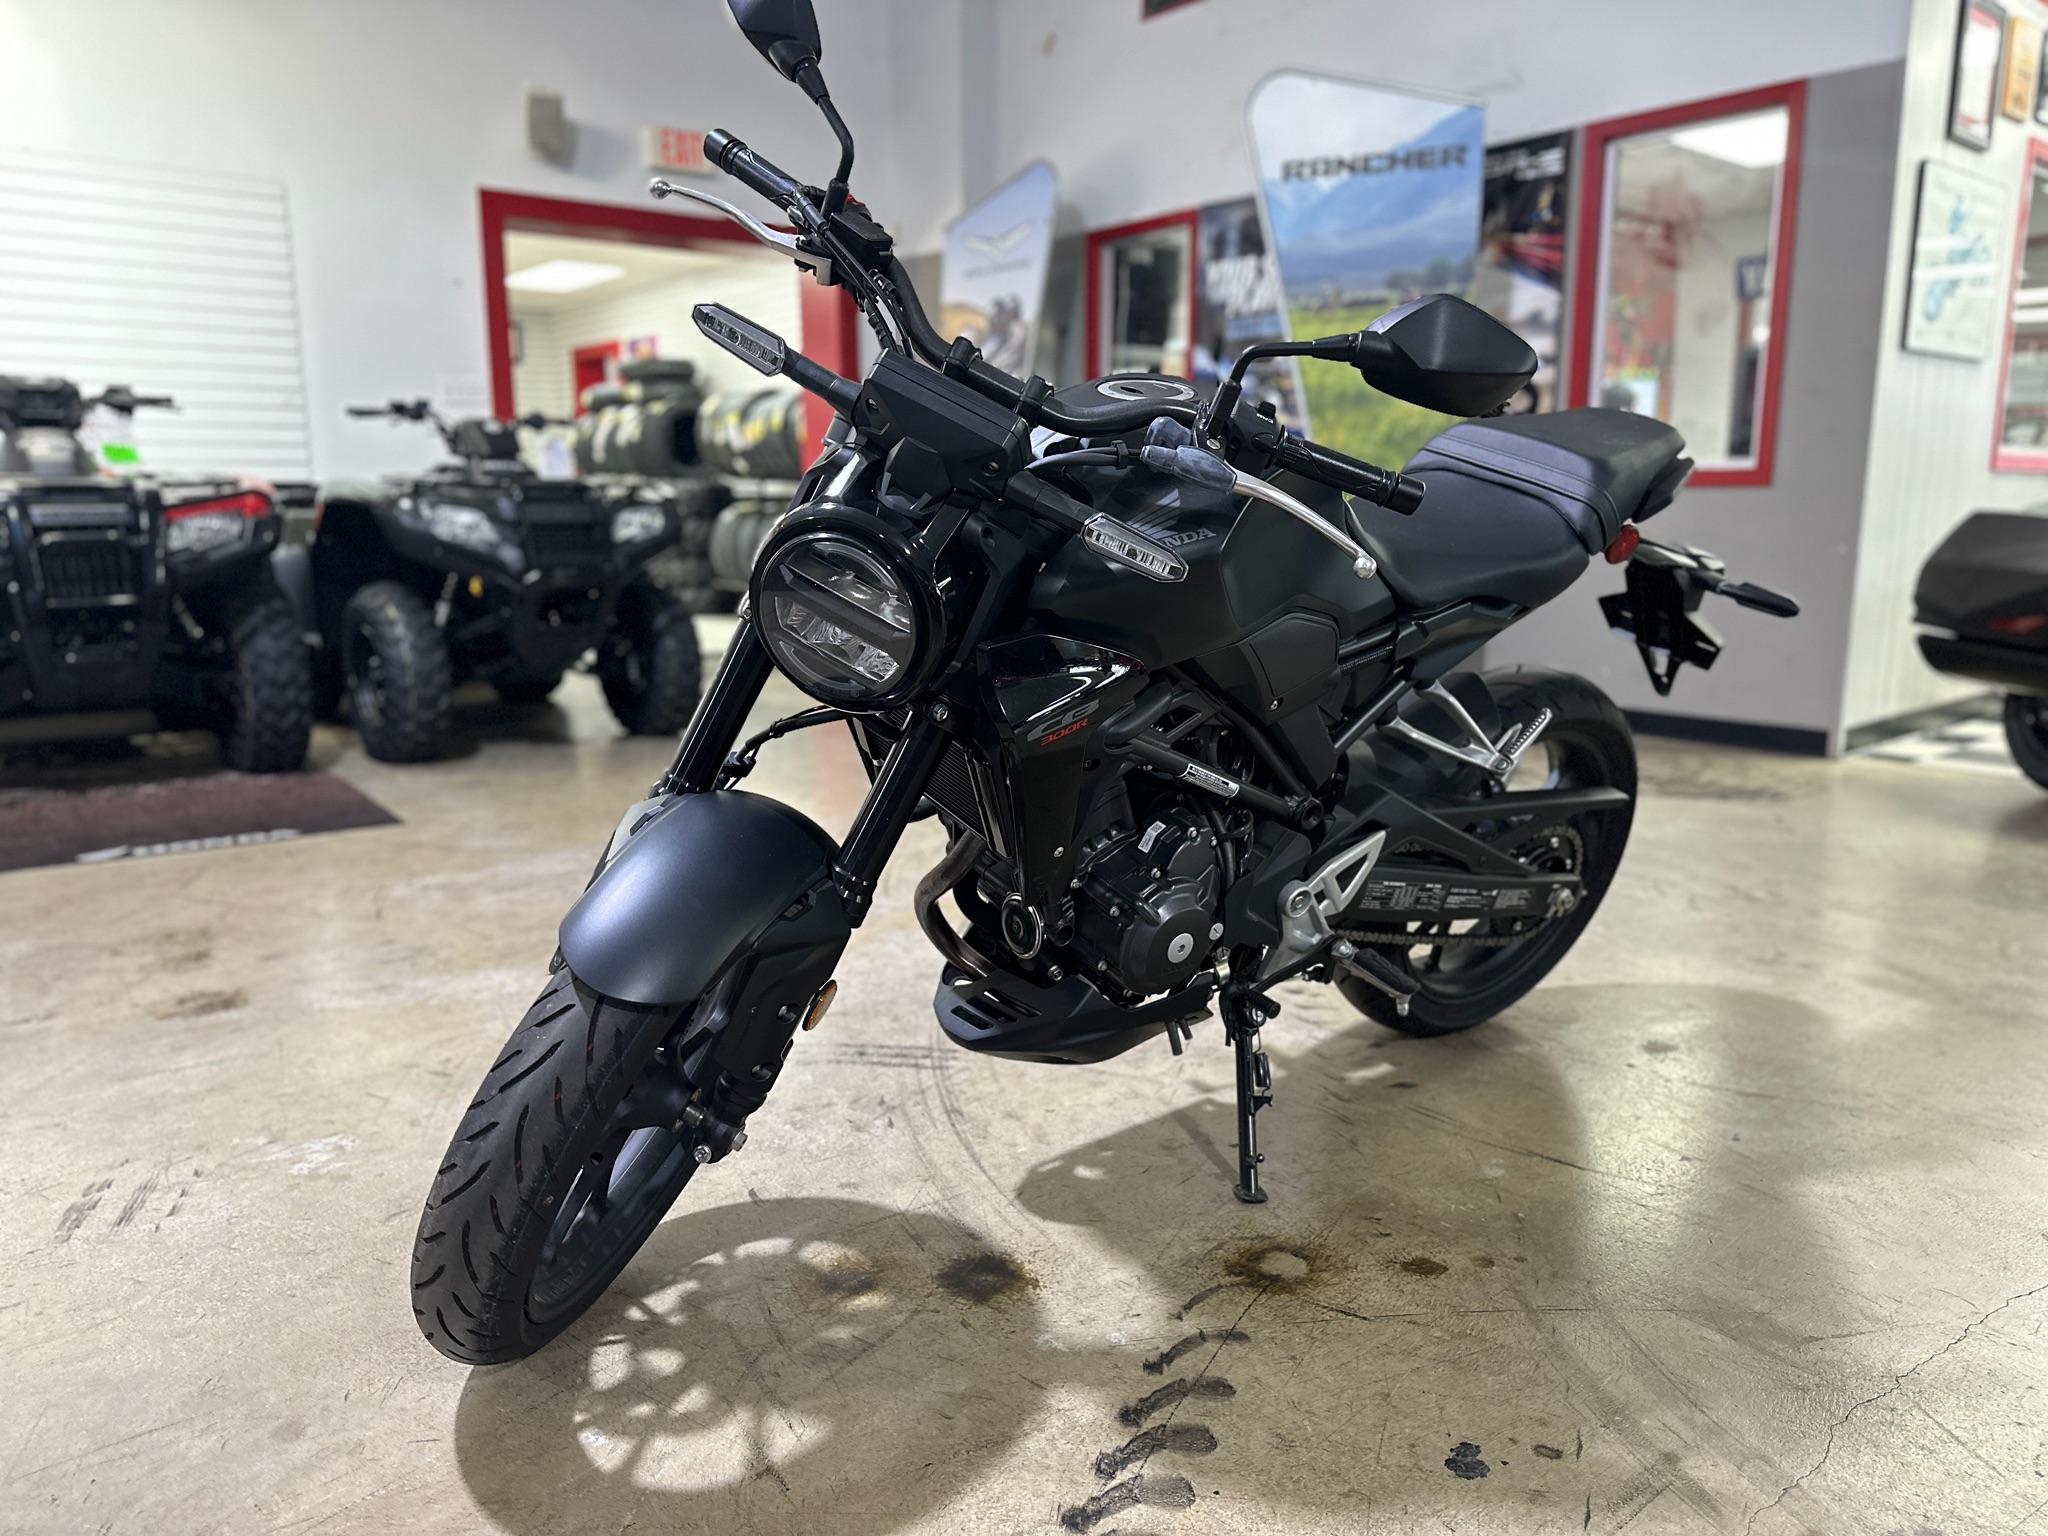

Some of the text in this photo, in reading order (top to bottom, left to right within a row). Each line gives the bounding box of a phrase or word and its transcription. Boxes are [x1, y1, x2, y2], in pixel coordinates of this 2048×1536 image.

[1282, 143, 1469, 182] RANCHER
[1162, 526, 1217, 548] NDA
[1041, 717, 1089, 746] 300R
